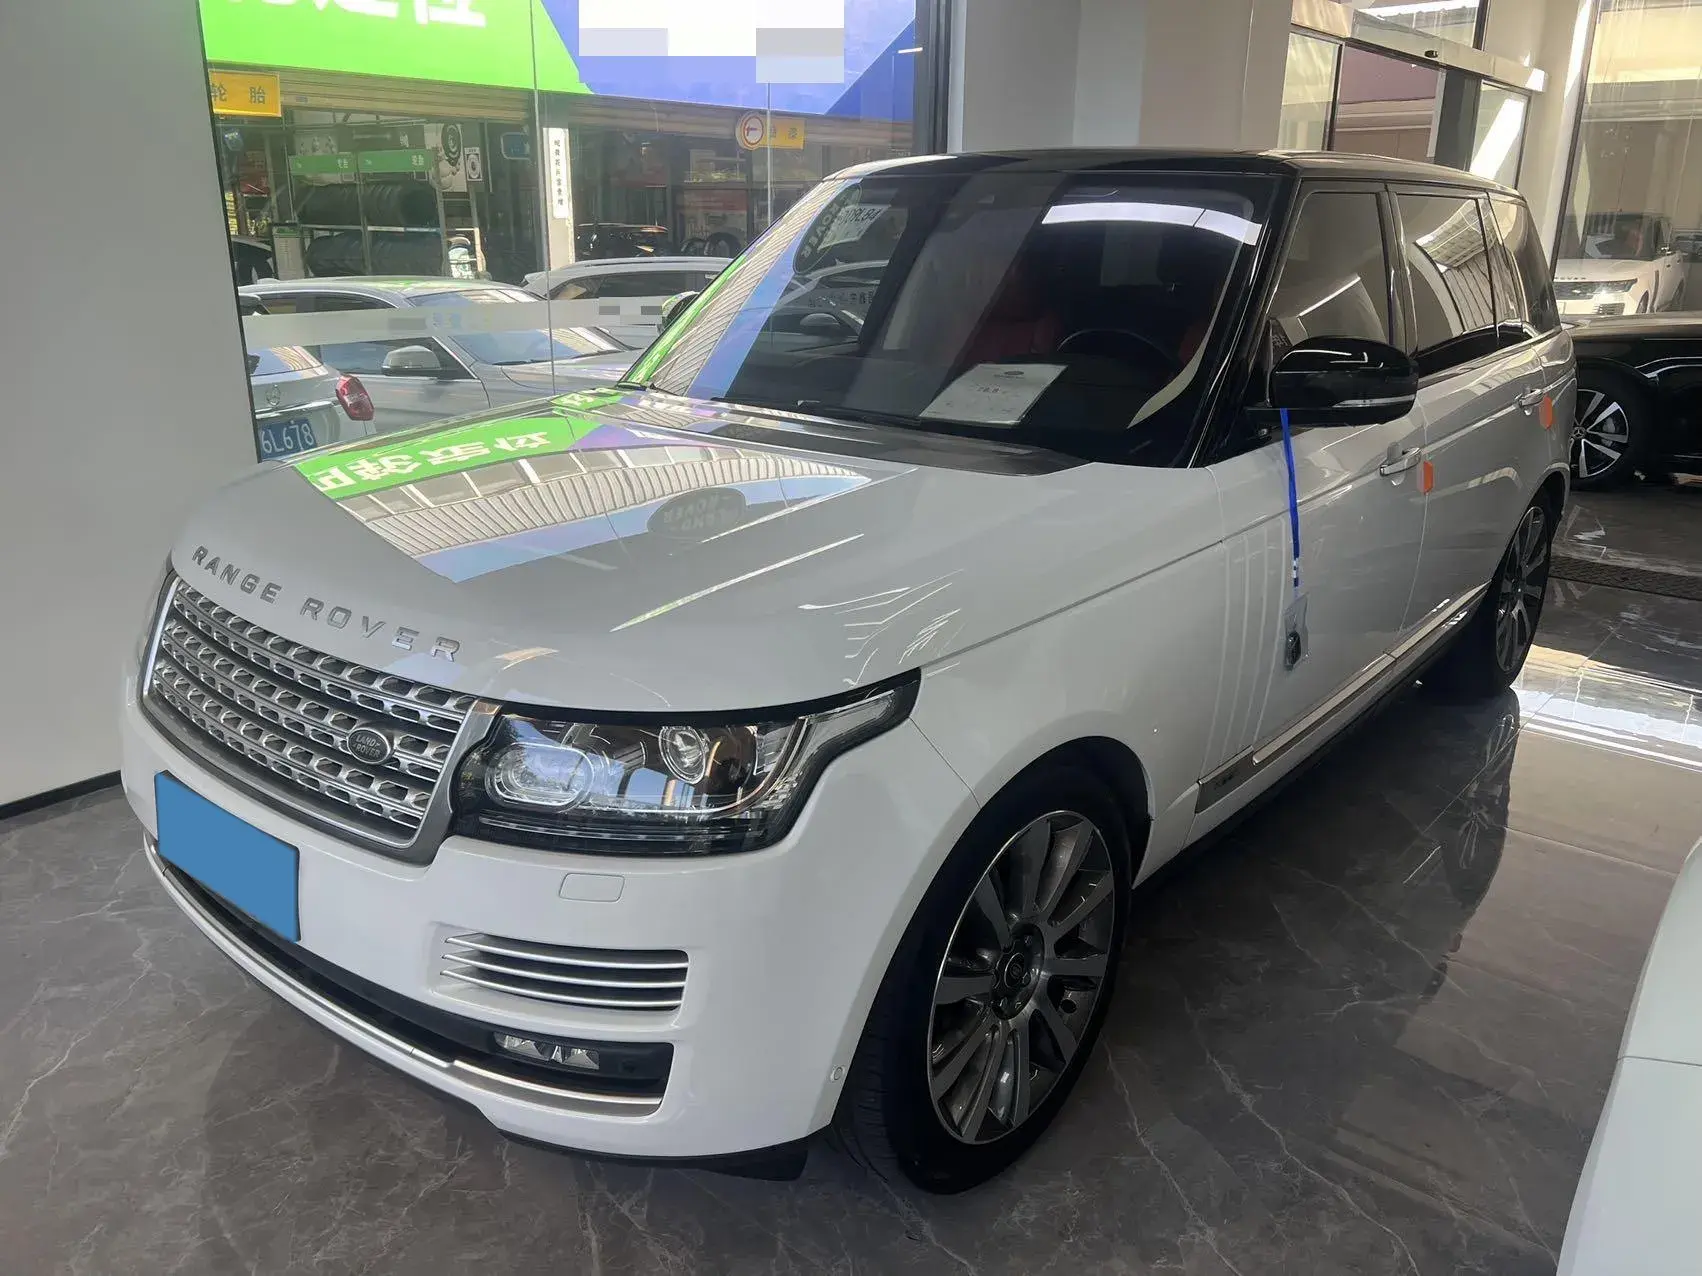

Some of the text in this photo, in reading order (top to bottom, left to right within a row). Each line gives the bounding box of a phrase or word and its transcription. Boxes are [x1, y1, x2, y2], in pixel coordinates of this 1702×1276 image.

[261, 423, 315, 454] 6L678
[191, 545, 461, 663] RANGE ROVER
[355, 734, 377, 747] LAND
[355, 743, 381, 758] ROVER
